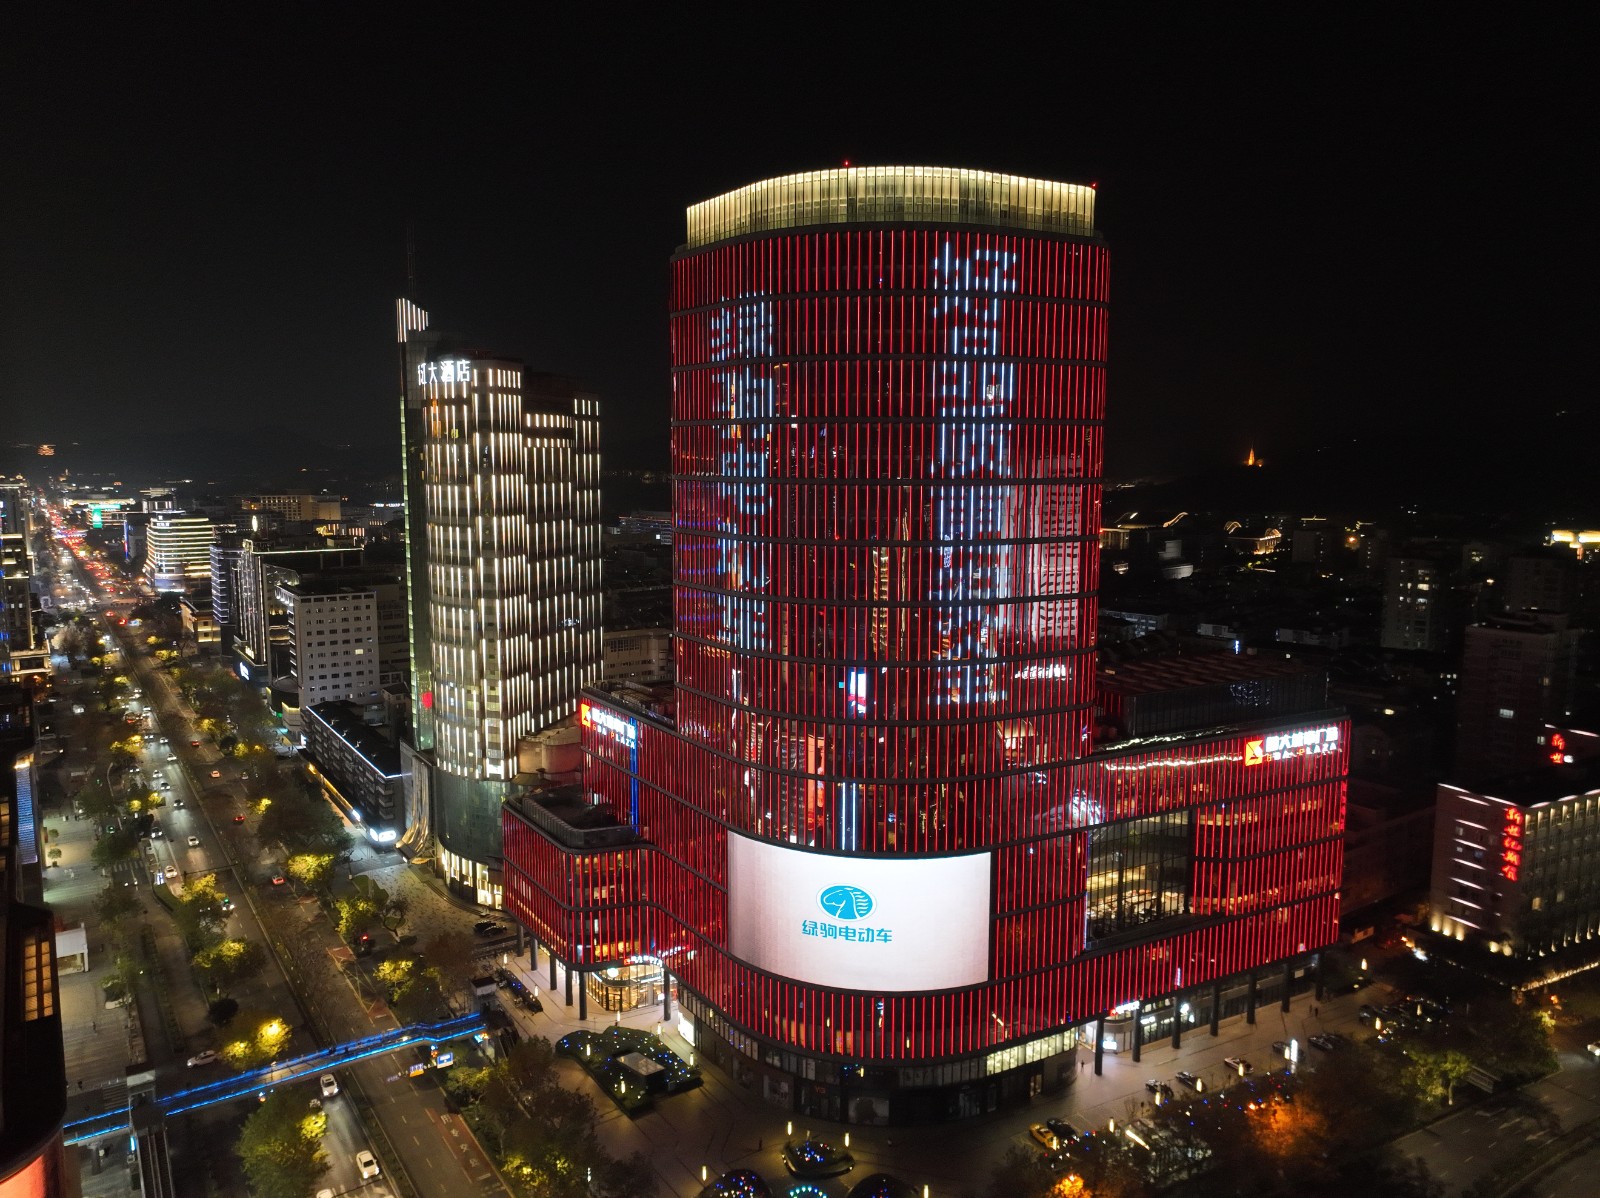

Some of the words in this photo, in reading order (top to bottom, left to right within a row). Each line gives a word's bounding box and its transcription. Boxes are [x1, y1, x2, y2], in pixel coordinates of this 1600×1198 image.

[802, 920, 892, 943] 绿驹电动车
